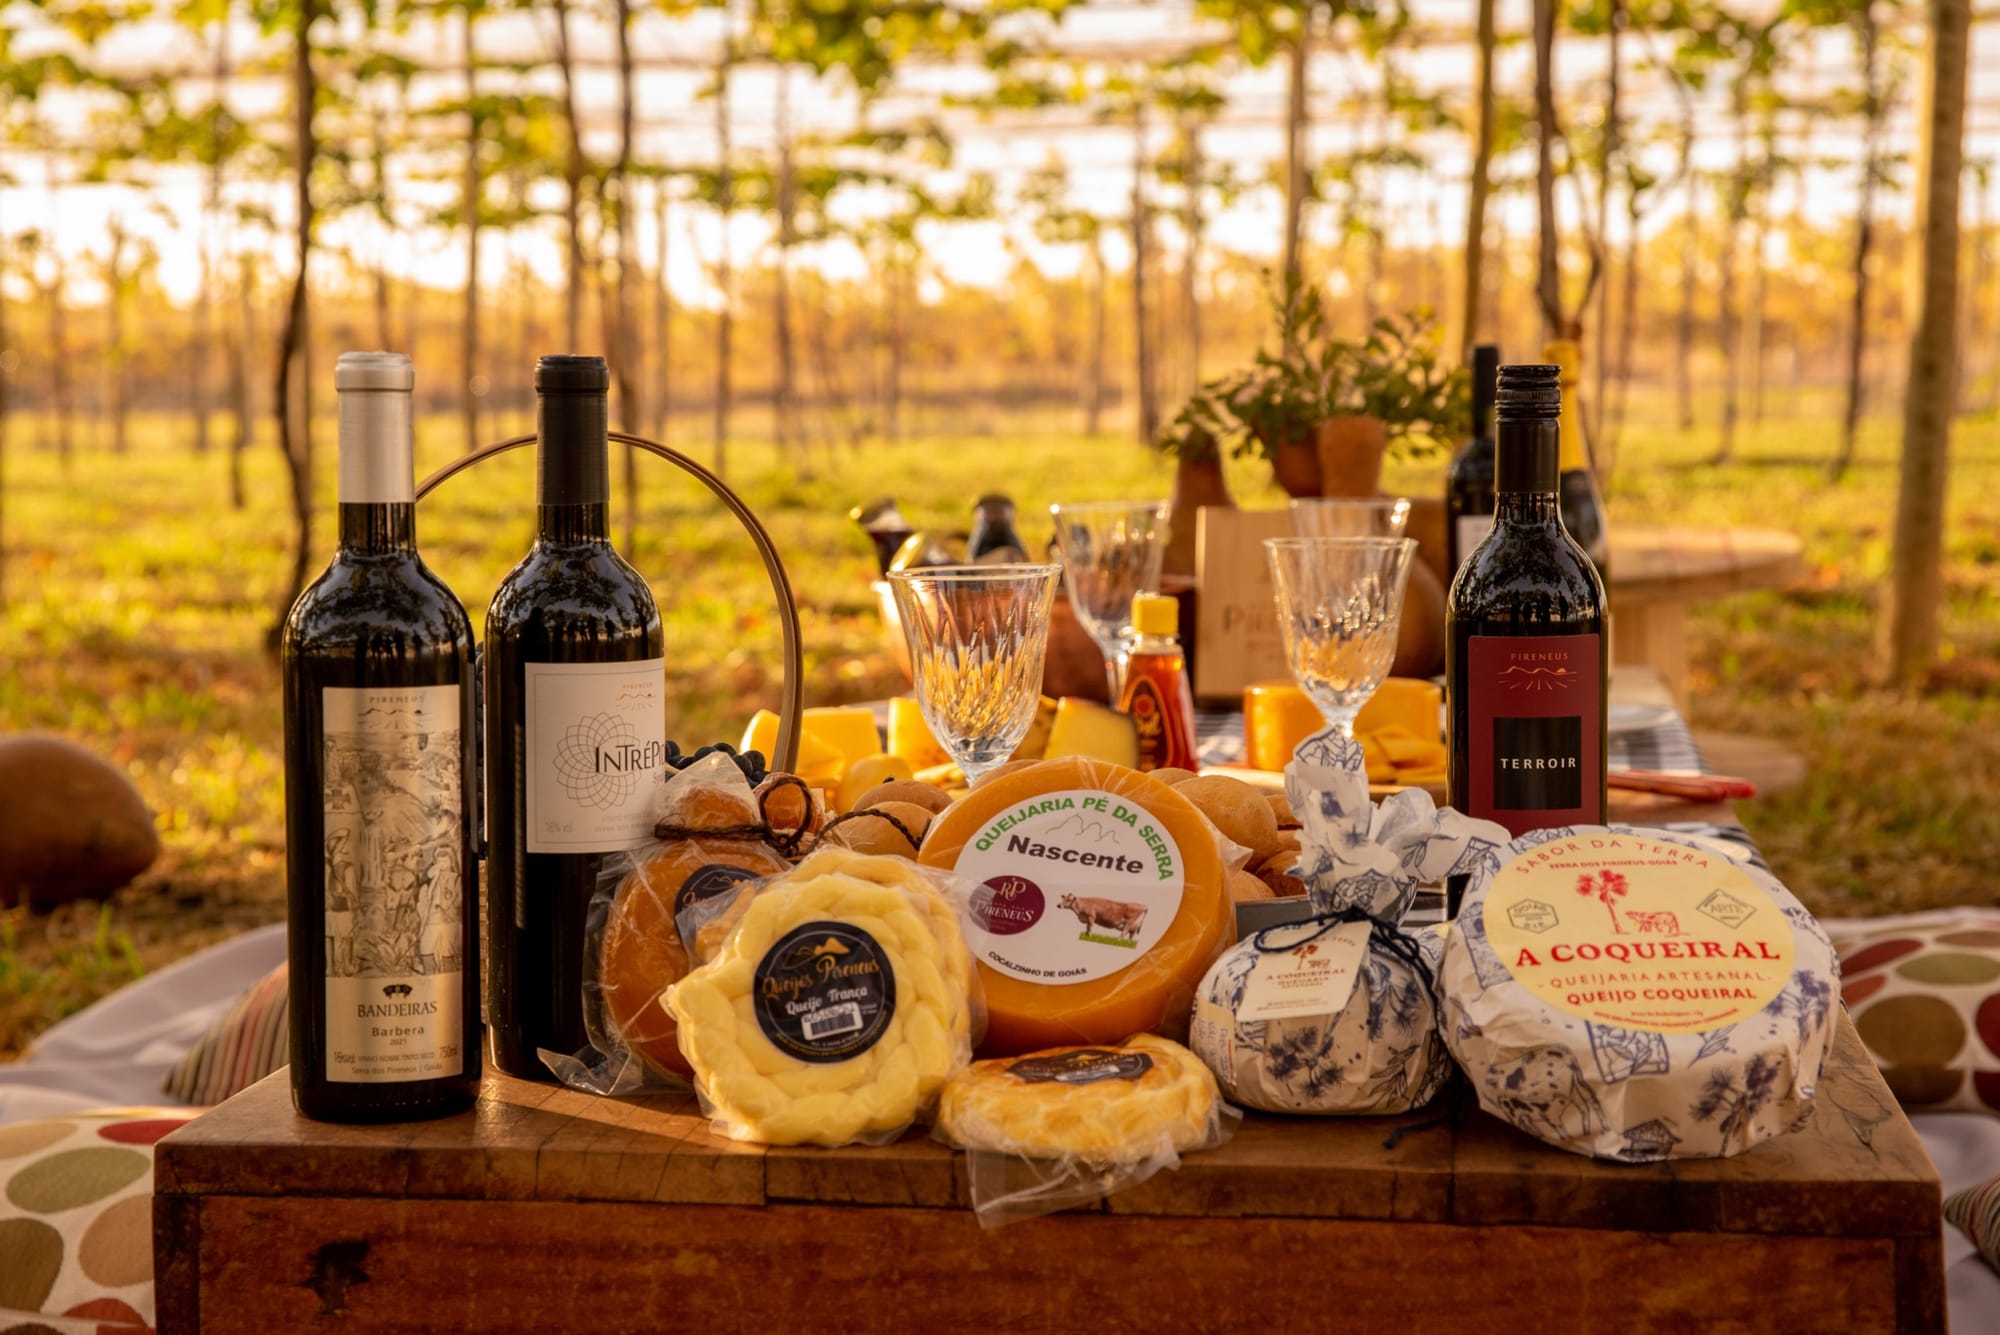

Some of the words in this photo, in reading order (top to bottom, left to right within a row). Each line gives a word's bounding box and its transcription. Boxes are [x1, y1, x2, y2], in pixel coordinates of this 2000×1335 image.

[1511, 652, 1568, 661] PIRENEUS
[1501, 757, 1577, 769] TERROIR
[975, 797, 1075, 852] QUEIJARIA
[1081, 796, 1110, 813] PÉ
[1111, 804, 1139, 828] DA
[1138, 825, 1175, 881] SERRA
[1007, 834, 1144, 874] Nascente
[1516, 842, 1580, 874] SABOR
[1590, 839, 1622, 849] DA
[1636, 842, 1708, 869] TERRA
[974, 900, 1034, 922] PIRENEUS
[988, 951, 1041, 976] COCALZINHO
[1058, 967, 1087, 977] GOIÁS
[1516, 948, 1541, 967] A
[1550, 941, 1781, 964] COQUEIRAL
[1550, 972, 1650, 989] QUEIJARIA
[1656, 970, 1767, 982] ARTESANAL
[785, 996, 823, 1016] Queijo
[827, 986, 868, 1002] Trança
[1567, 990, 1637, 1006] QUEIJO
[1642, 988, 1757, 1002] COQUEIRAL
[357, 1001, 437, 1018] BANDEIRAS
[371, 1026, 425, 1037] Barbera
